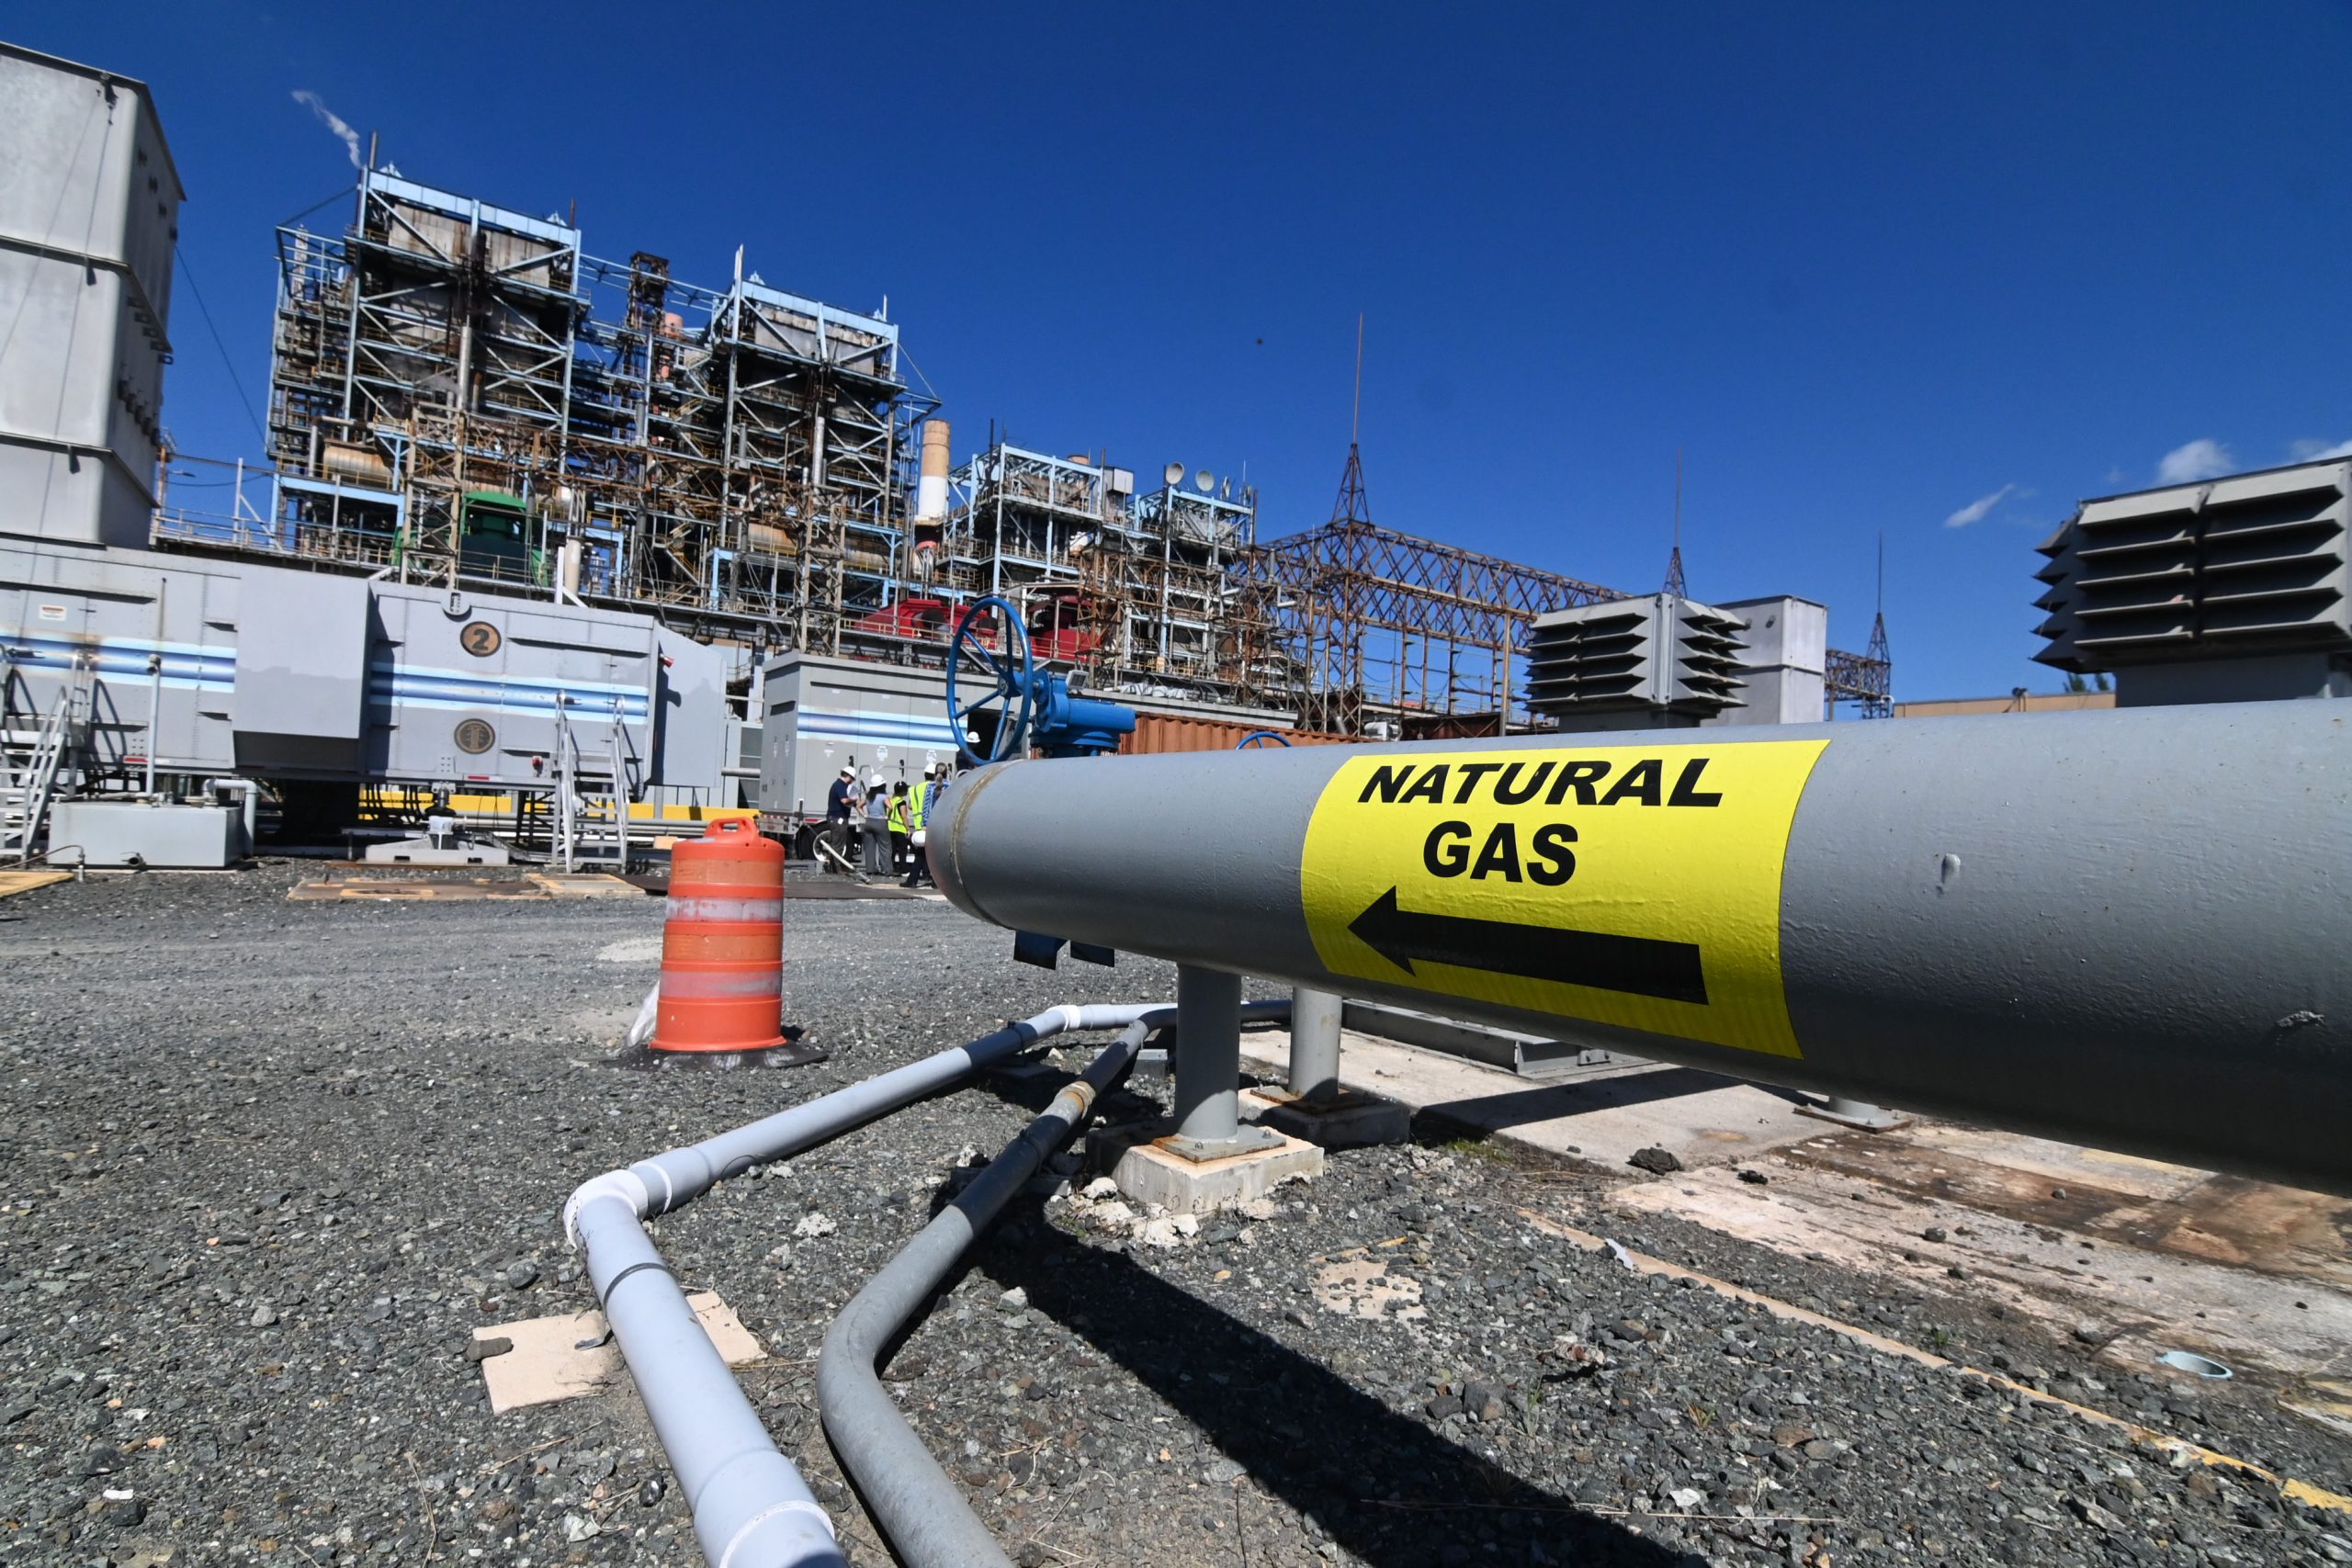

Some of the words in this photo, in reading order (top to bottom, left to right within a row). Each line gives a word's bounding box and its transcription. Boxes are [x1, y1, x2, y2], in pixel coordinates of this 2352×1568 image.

[472, 628, 490, 650] 2
[1357, 758, 1723, 807] NATURAL
[1423, 820, 1578, 886] GAS
